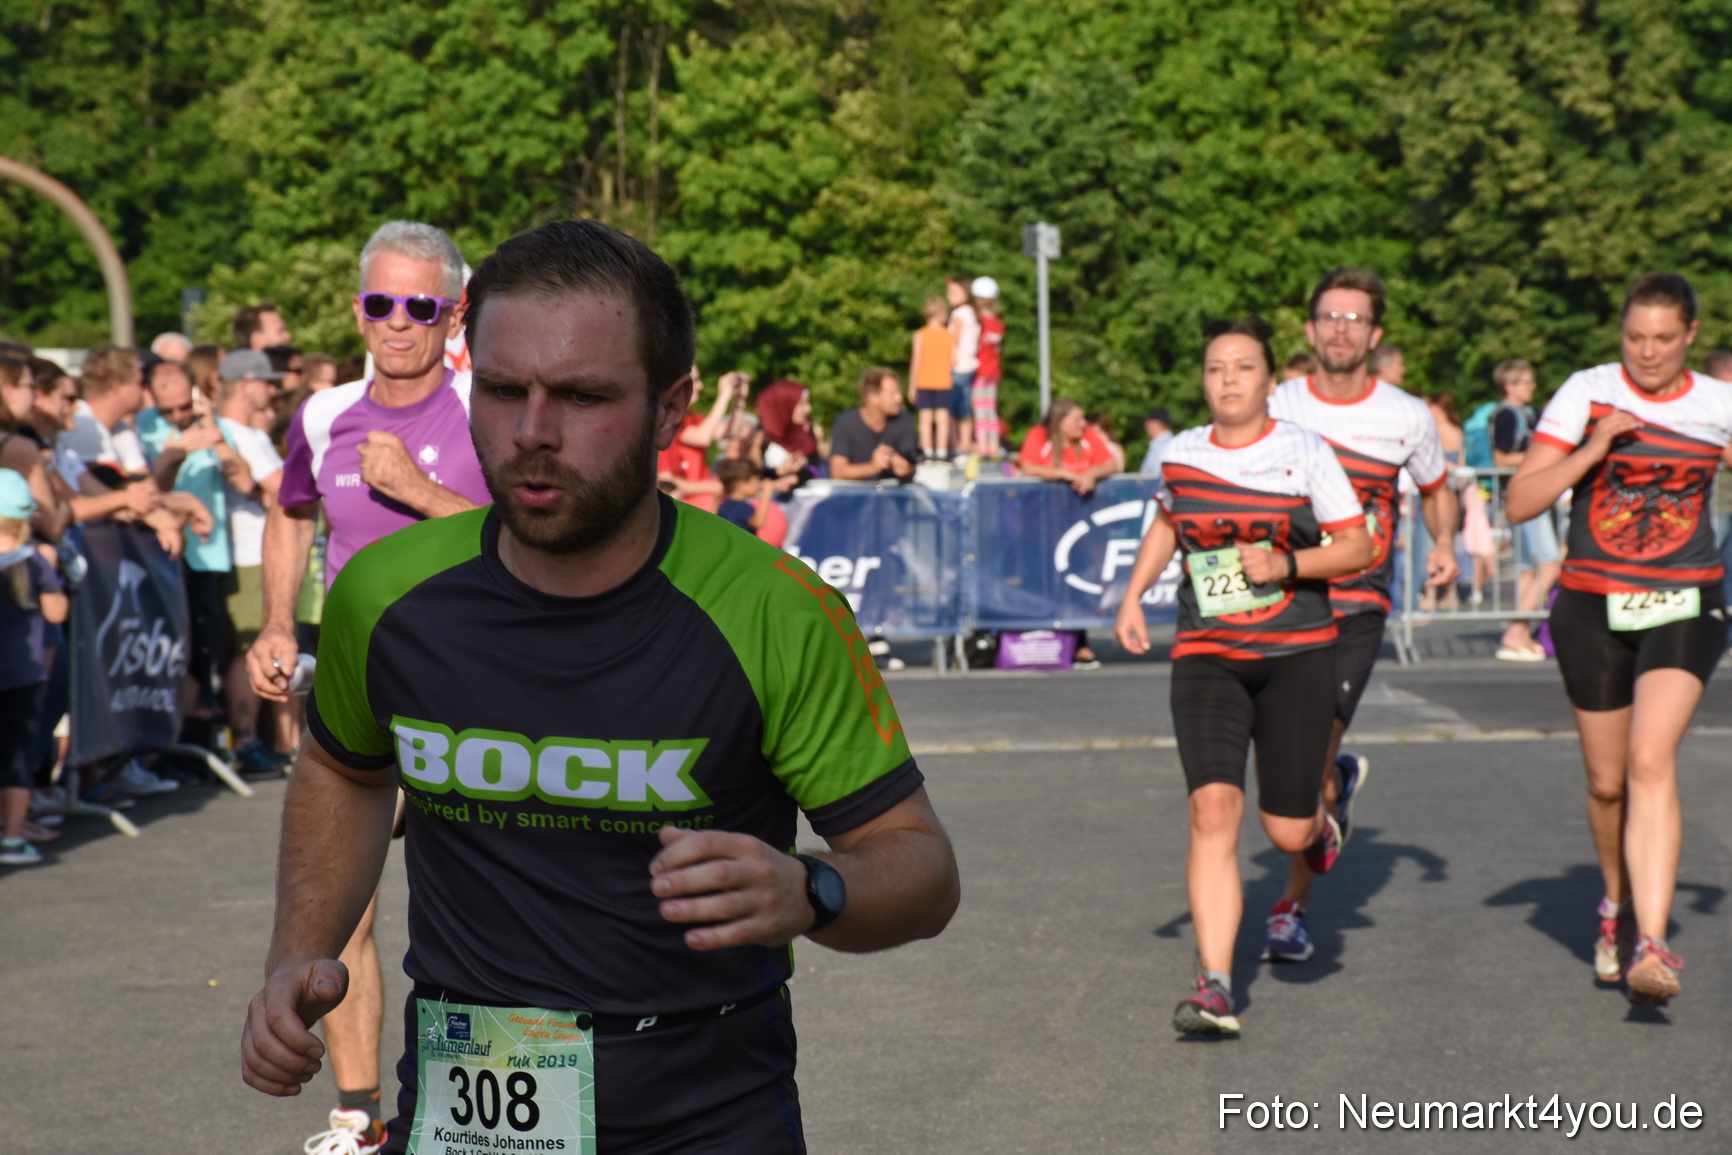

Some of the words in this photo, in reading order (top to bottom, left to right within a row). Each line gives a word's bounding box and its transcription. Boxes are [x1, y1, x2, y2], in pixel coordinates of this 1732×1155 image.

[335, 473, 361, 488] WIR
[1203, 571, 1250, 597] 223
[392, 719, 705, 806] BOCK
[478, 804, 508, 830] by
[517, 812, 592, 832] smart
[537, 1054, 578, 1068] 2019
[448, 1066, 540, 1132] 308
[433, 1127, 490, 1147] Kourtides
[492, 1134, 566, 1150] Johannes
